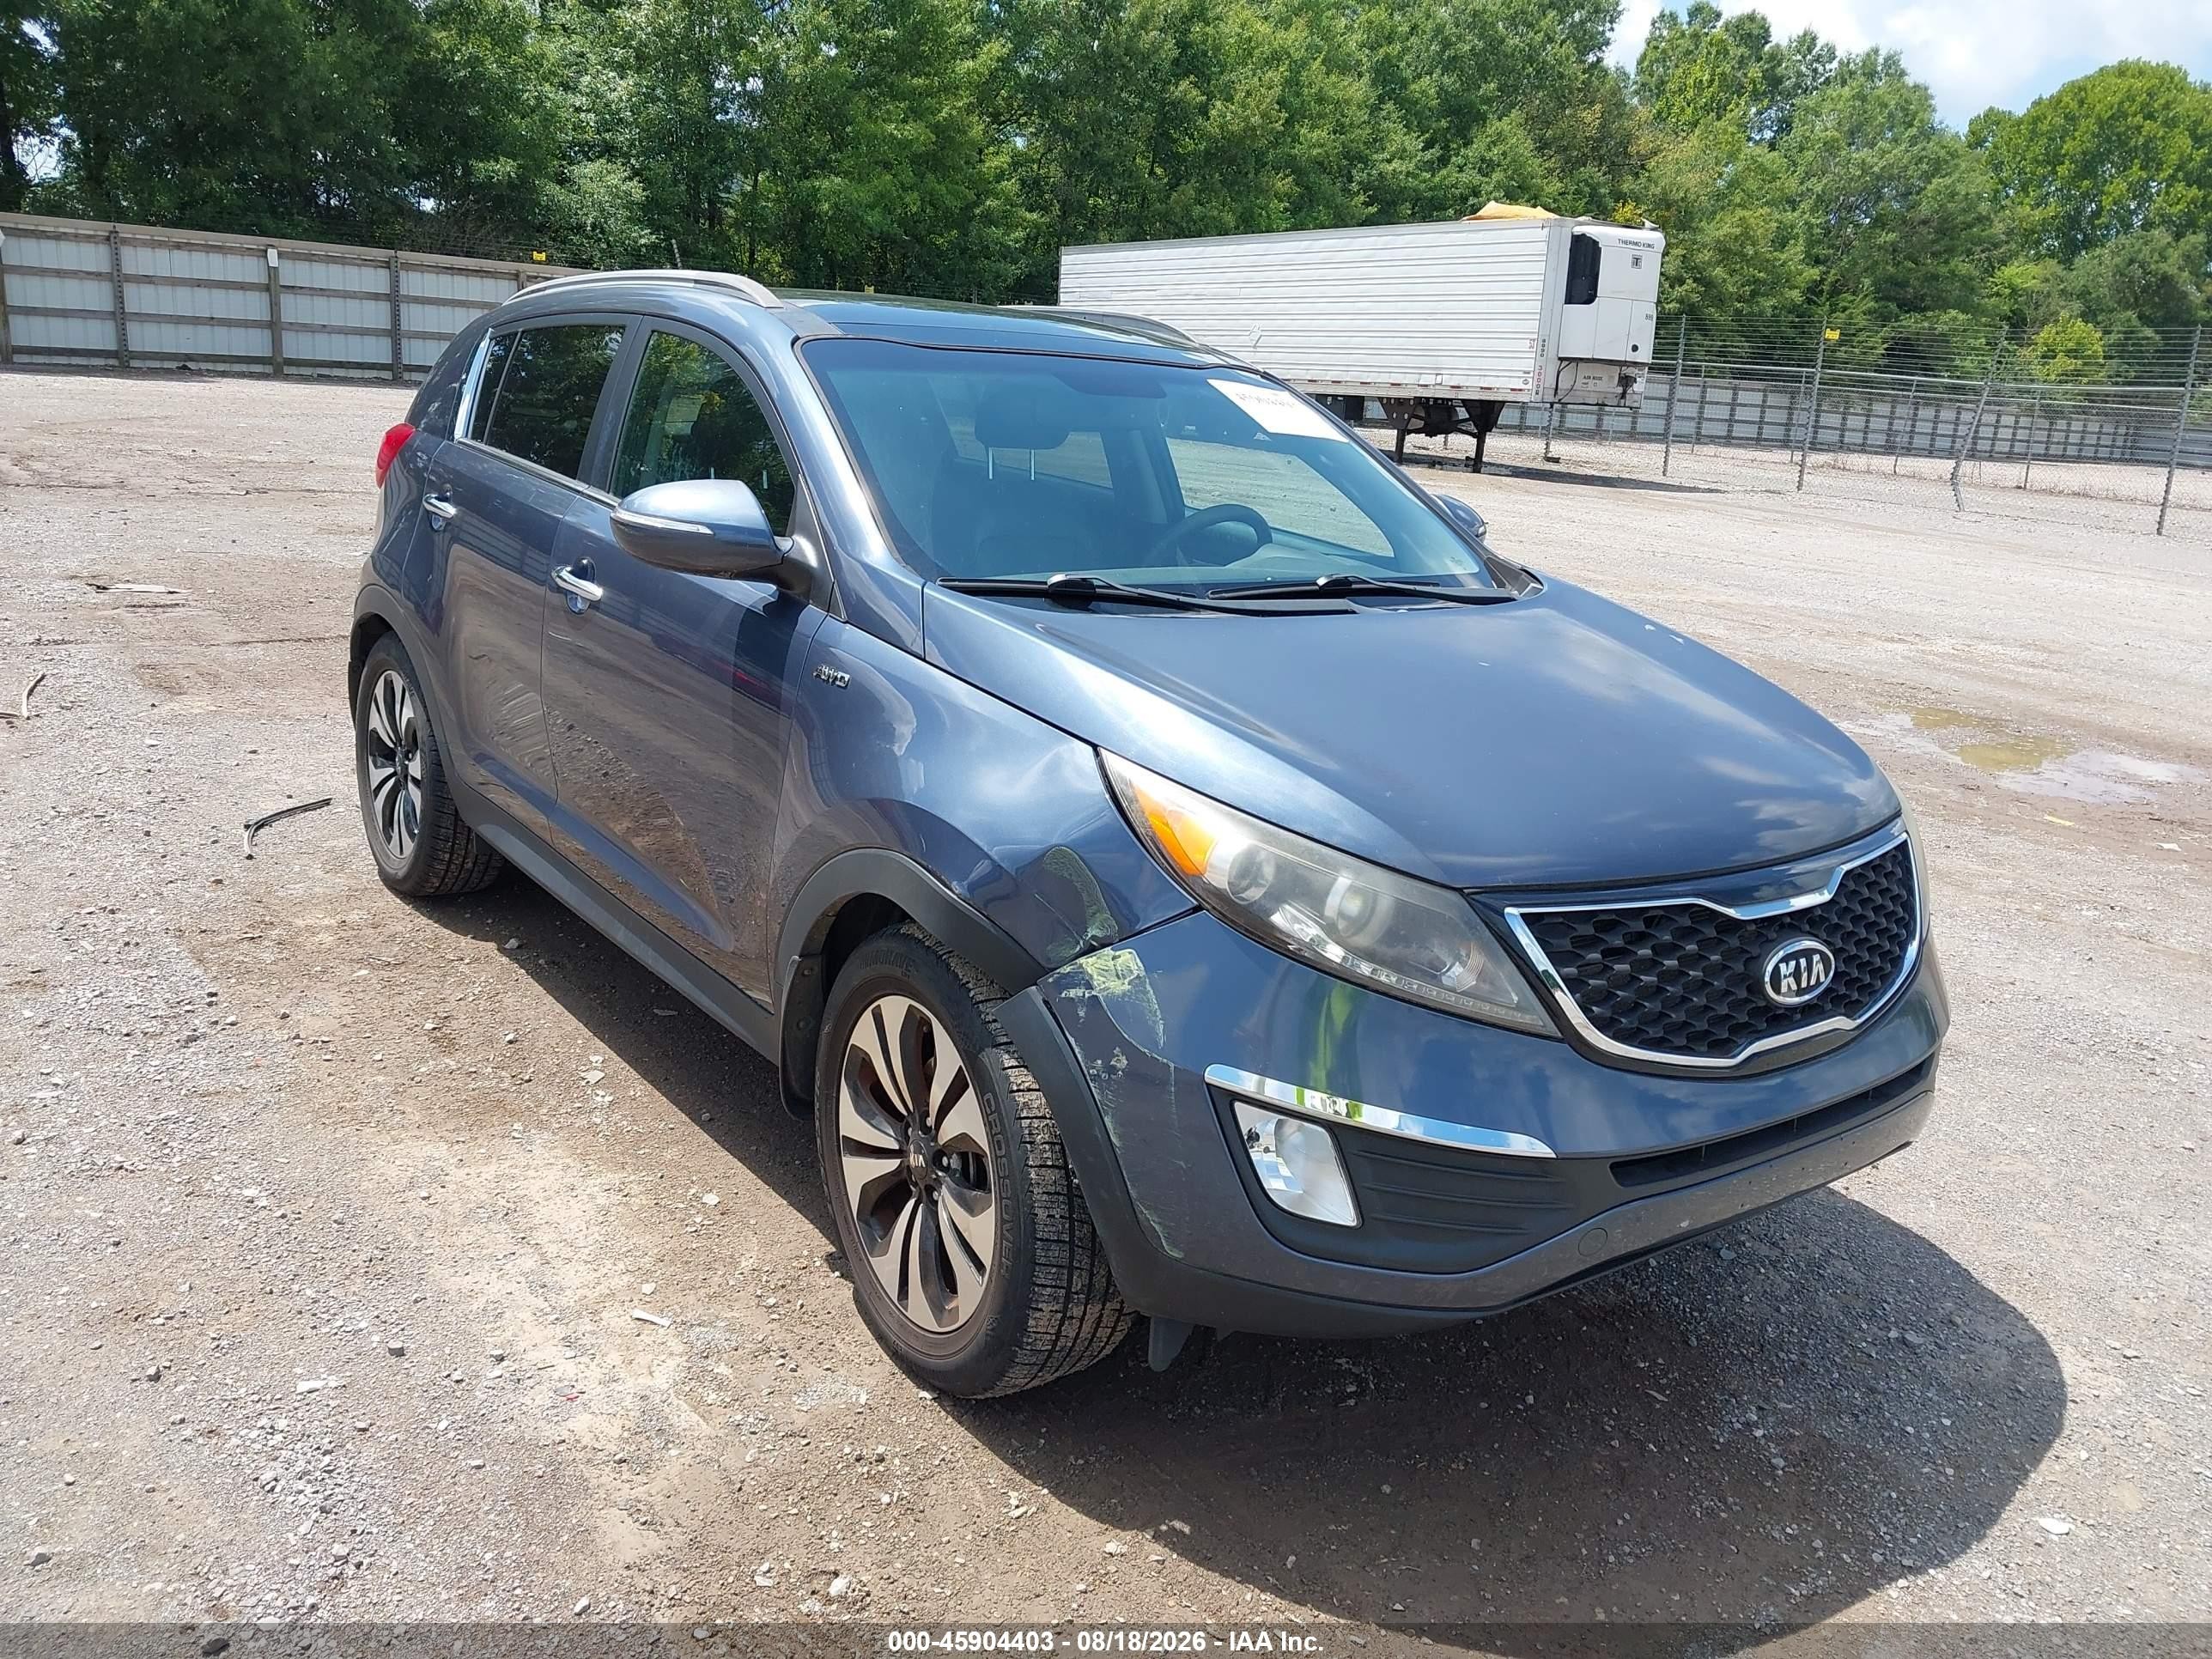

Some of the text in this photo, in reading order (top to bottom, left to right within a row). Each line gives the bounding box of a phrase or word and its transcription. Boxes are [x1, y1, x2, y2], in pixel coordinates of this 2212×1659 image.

[1617, 238, 1642, 247] THERMO
[813, 664, 851, 689] AWD
[1778, 953, 1826, 994] KIA
[909, 1152, 927, 1169] KIA
[981, 1091, 1014, 1279] CROSSOVER
